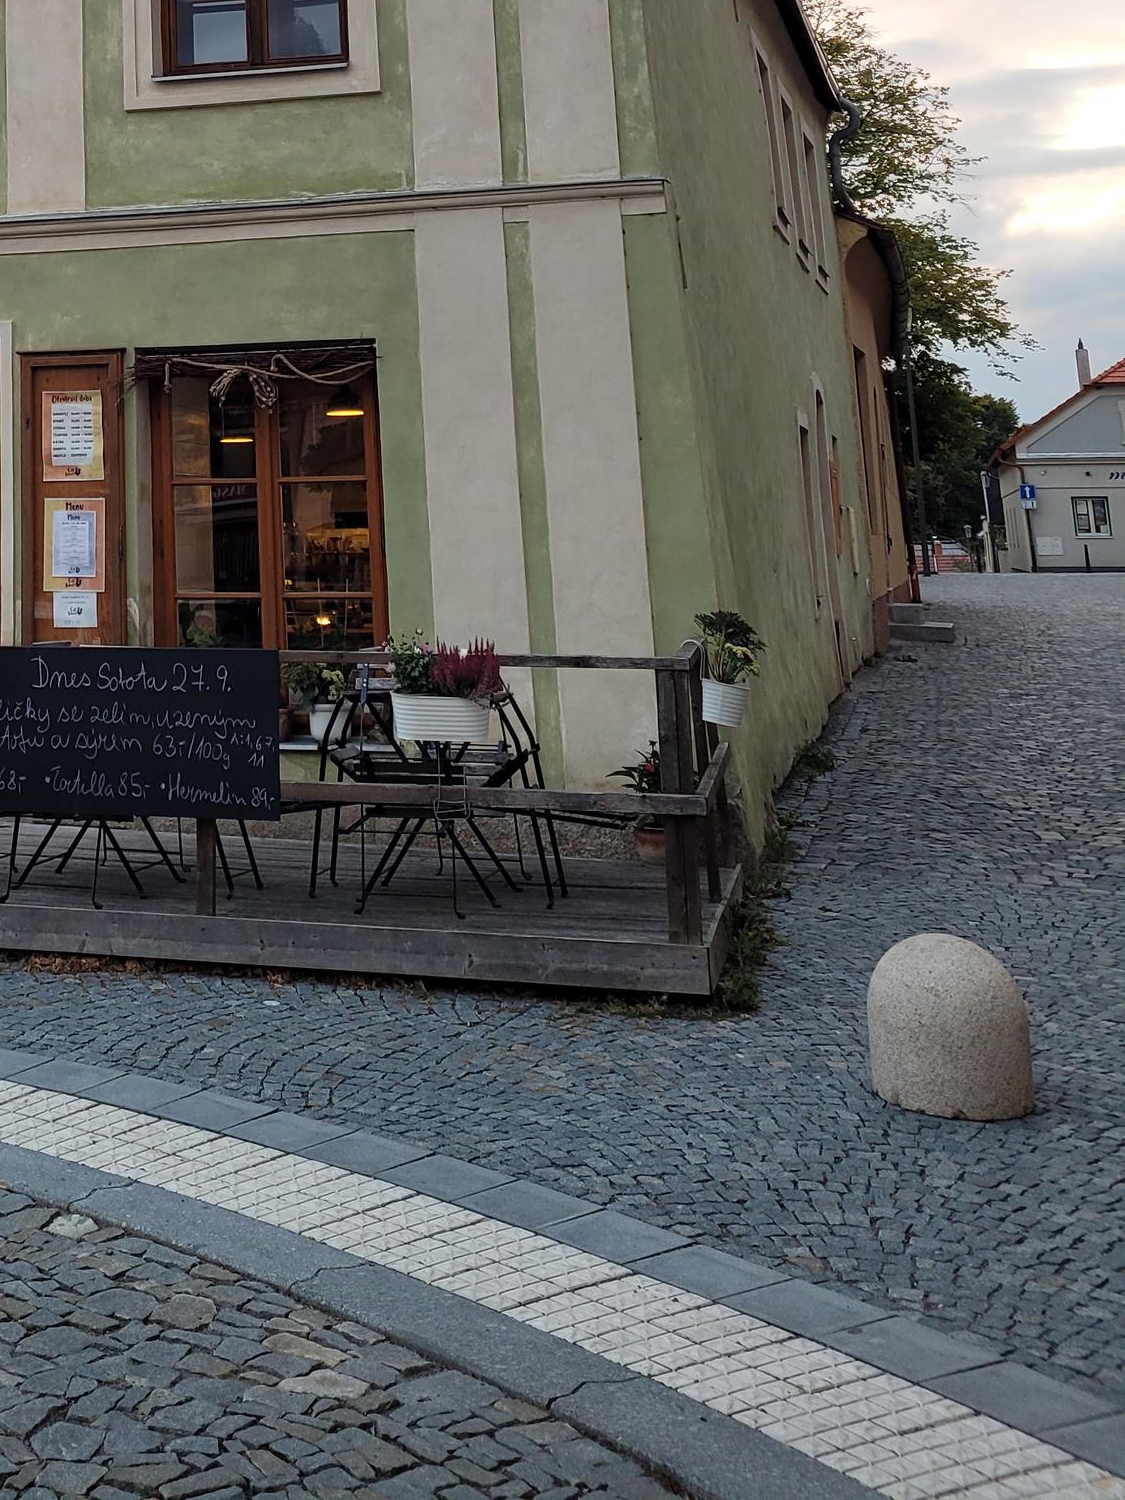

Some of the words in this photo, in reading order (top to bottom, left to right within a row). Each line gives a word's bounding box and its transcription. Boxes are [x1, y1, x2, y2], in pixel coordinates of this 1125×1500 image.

[65, 501, 84, 511] Menu
[30, 655, 91, 689] Dnes
[97, 661, 168, 692] Sobota
[57, 705, 83, 723] se
[50, 733, 70, 749] a
[74, 728, 142, 760] sýrem
[50, 764, 115, 800] Tortilla
